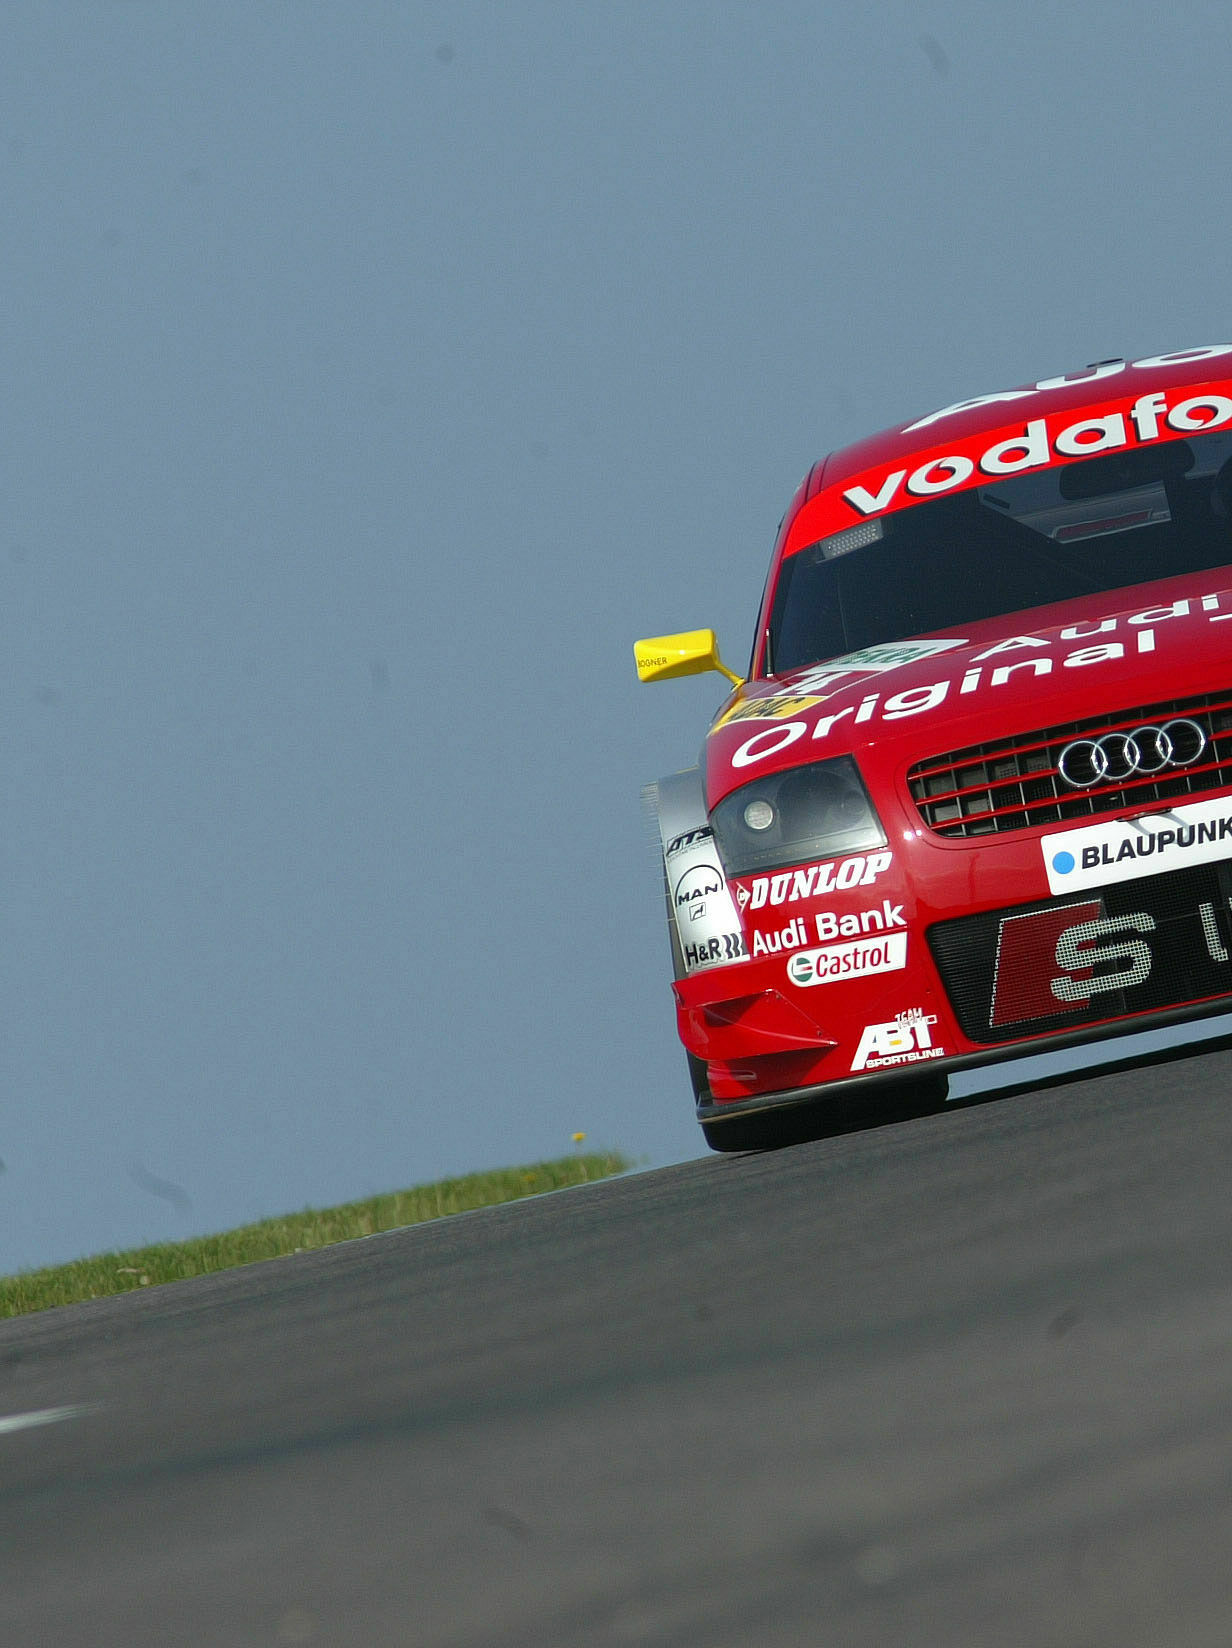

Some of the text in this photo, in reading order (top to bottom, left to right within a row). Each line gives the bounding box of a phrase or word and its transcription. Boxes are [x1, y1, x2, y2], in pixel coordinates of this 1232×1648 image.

[969, 594, 1221, 663] Audi
[637, 656, 668, 669] OGNER
[731, 629, 1157, 768] Original
[678, 883, 718, 906] MAN
[749, 851, 893, 910] DUNLOP
[685, 937, 721, 968] H&R
[752, 899, 907, 957] Audi Bank
[816, 941, 891, 978] Castrol
[1050, 912, 1157, 1003] S
[850, 1014, 938, 1072] ABT
[866, 1047, 945, 1069] SPORTSLINE
